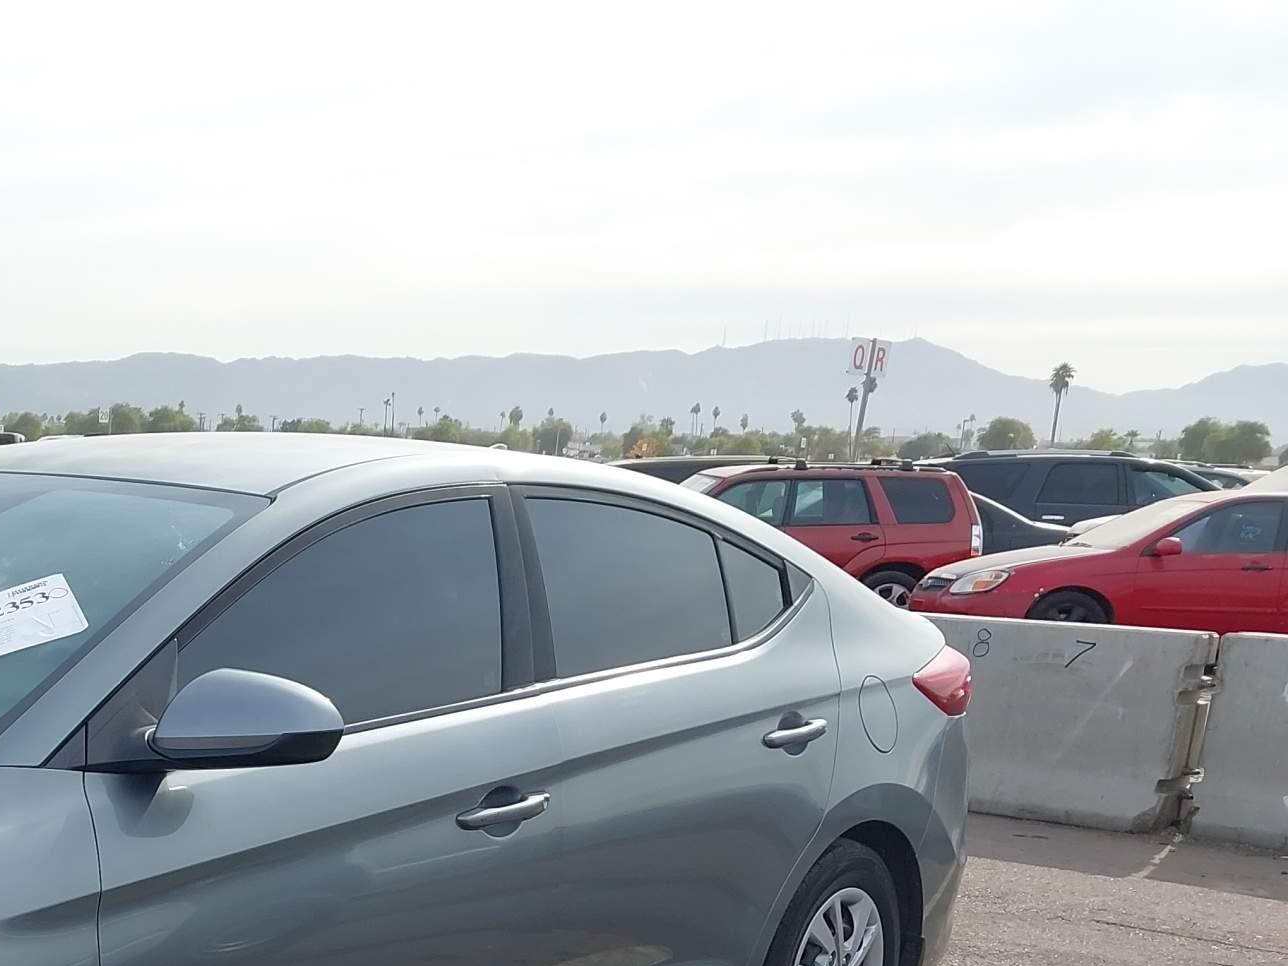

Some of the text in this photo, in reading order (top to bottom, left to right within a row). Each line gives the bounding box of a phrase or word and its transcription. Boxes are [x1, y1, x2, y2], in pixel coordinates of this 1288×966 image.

[853, 345, 865, 369] Q
[874, 347, 886, 372] R
[972, 628, 1097, 668] 8 7
